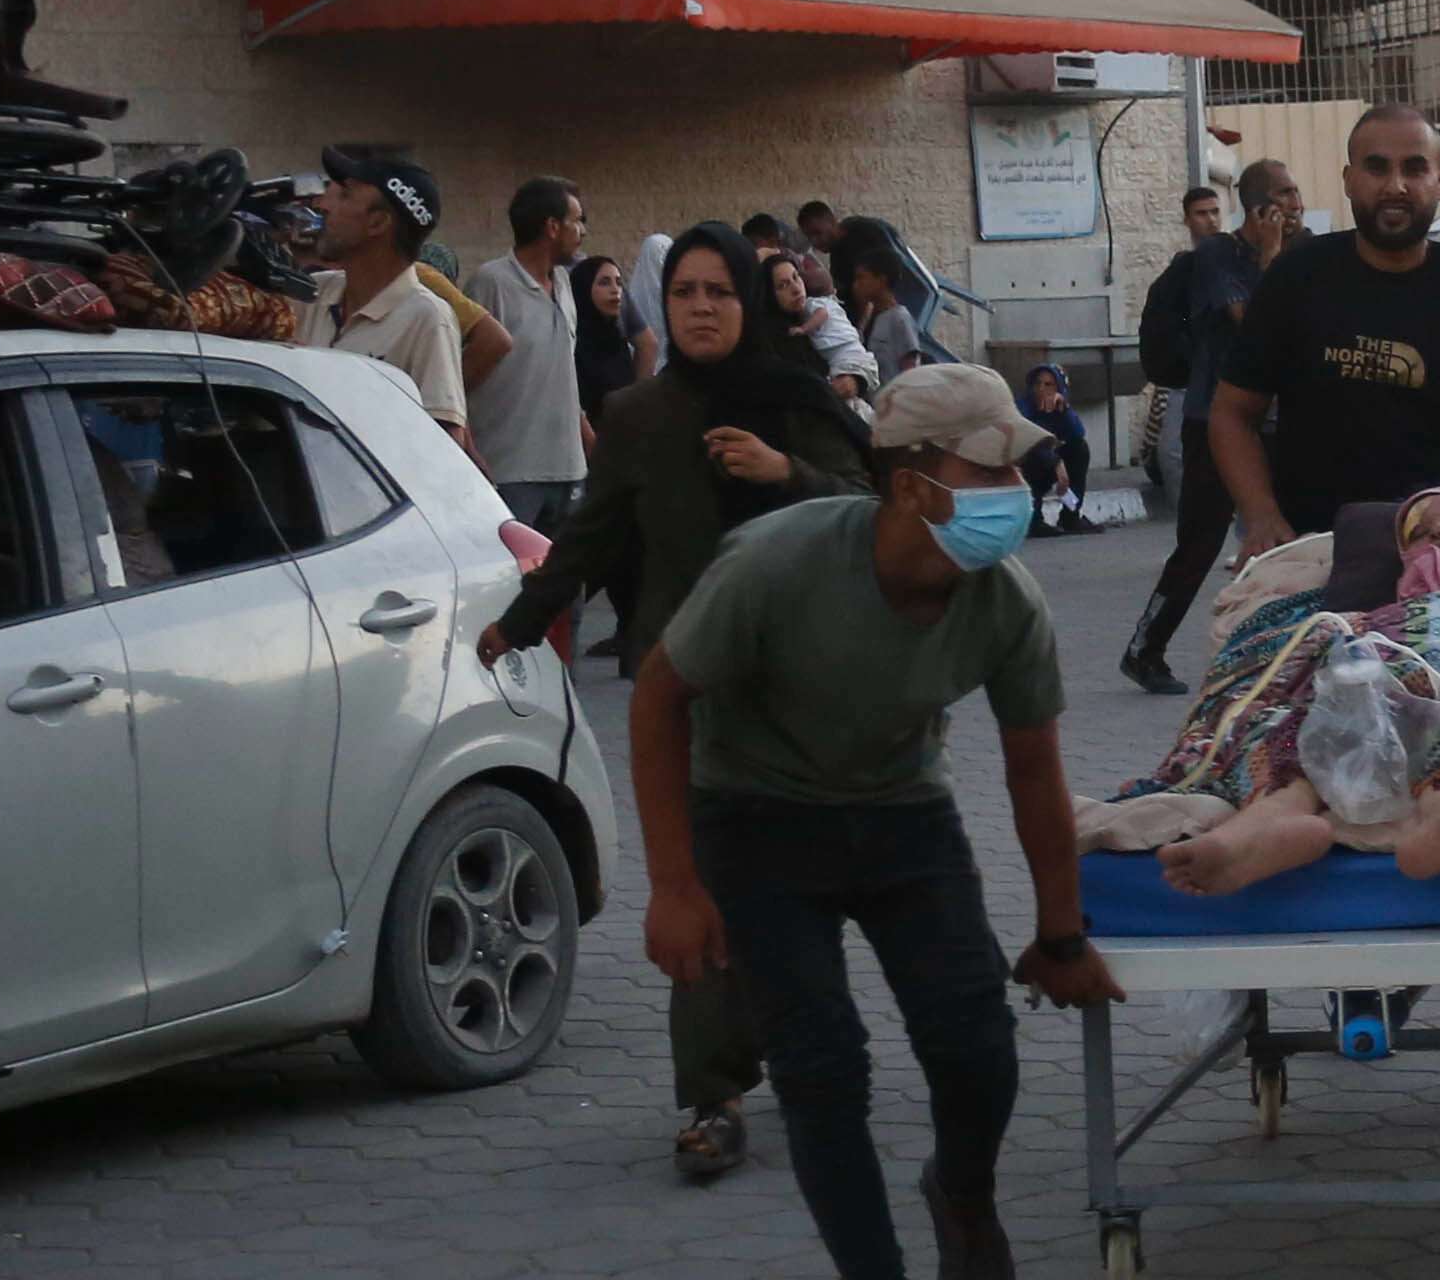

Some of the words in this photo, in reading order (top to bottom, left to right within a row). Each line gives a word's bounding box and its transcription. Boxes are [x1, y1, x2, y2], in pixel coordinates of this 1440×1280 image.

[387, 177, 433, 226] adidas
[1356, 335, 1392, 354] THE
[1324, 347, 1391, 369] NORTH
